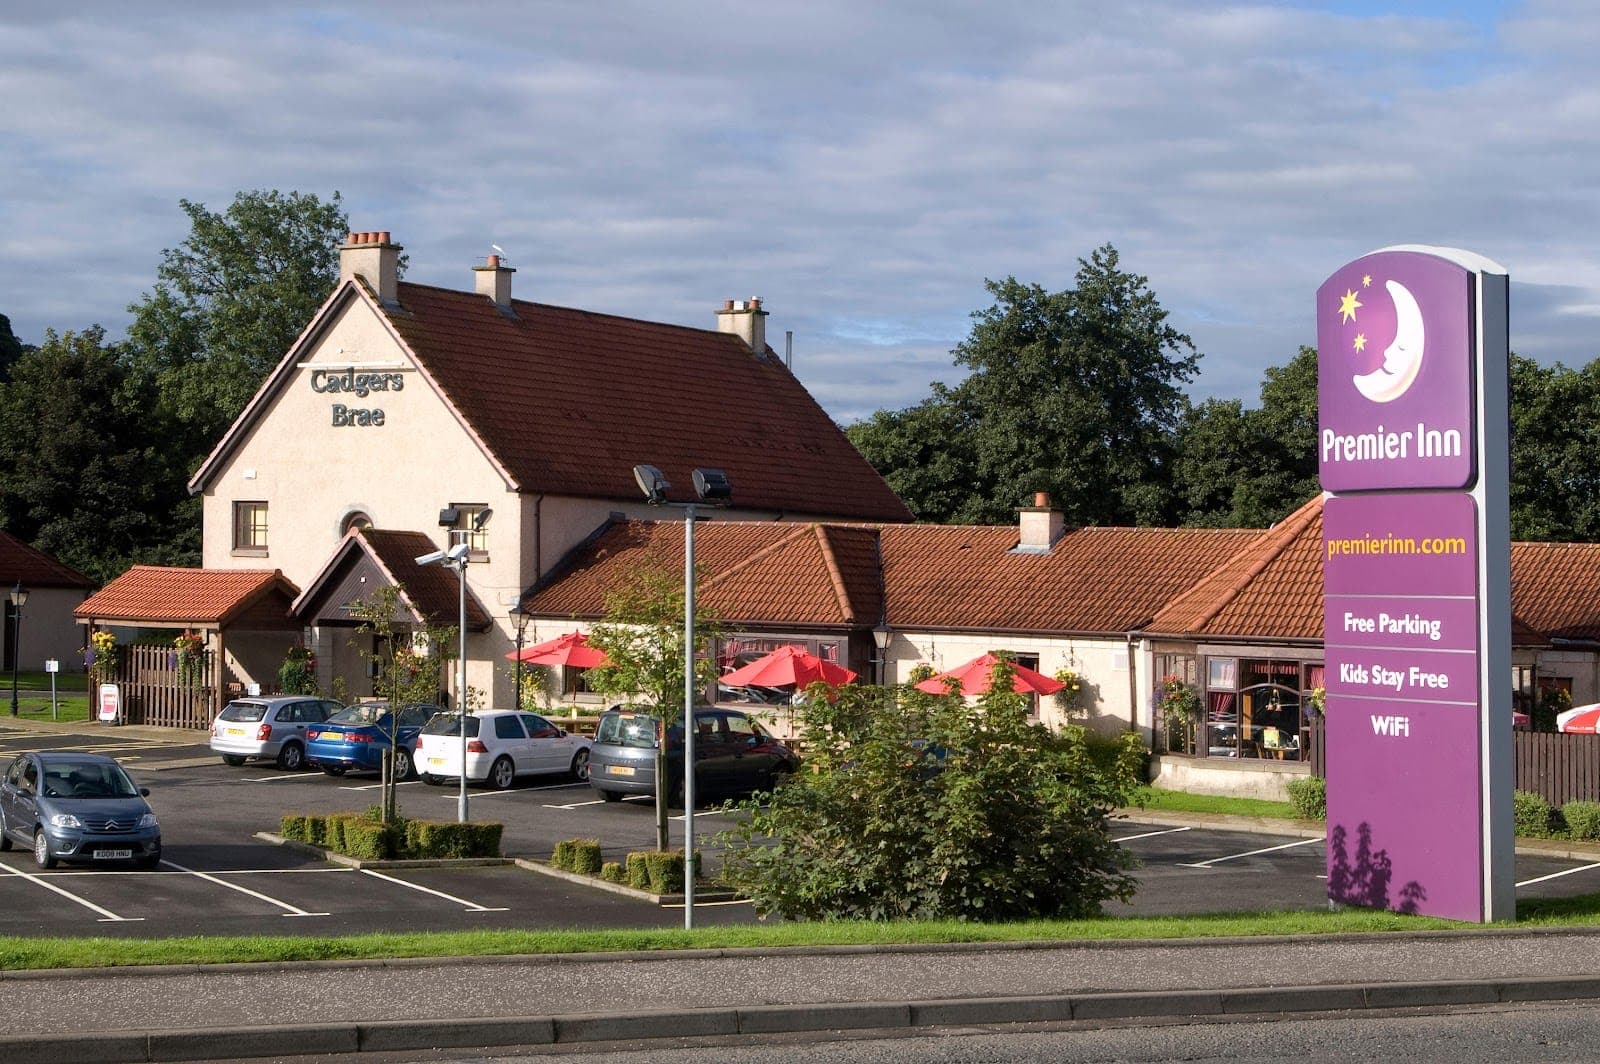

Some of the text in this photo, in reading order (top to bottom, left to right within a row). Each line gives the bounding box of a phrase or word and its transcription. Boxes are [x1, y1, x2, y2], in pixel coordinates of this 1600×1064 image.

[311, 367, 404, 398] Cadgers
[331, 404, 385, 427] Brae
[1322, 422, 1461, 463] Premier Inn
[1328, 533, 1466, 561] premierinn.com
[1344, 612, 1441, 640] Free Parking
[1340, 663, 1449, 691] Kids Stay Free
[1371, 715, 1409, 737] WiFi
